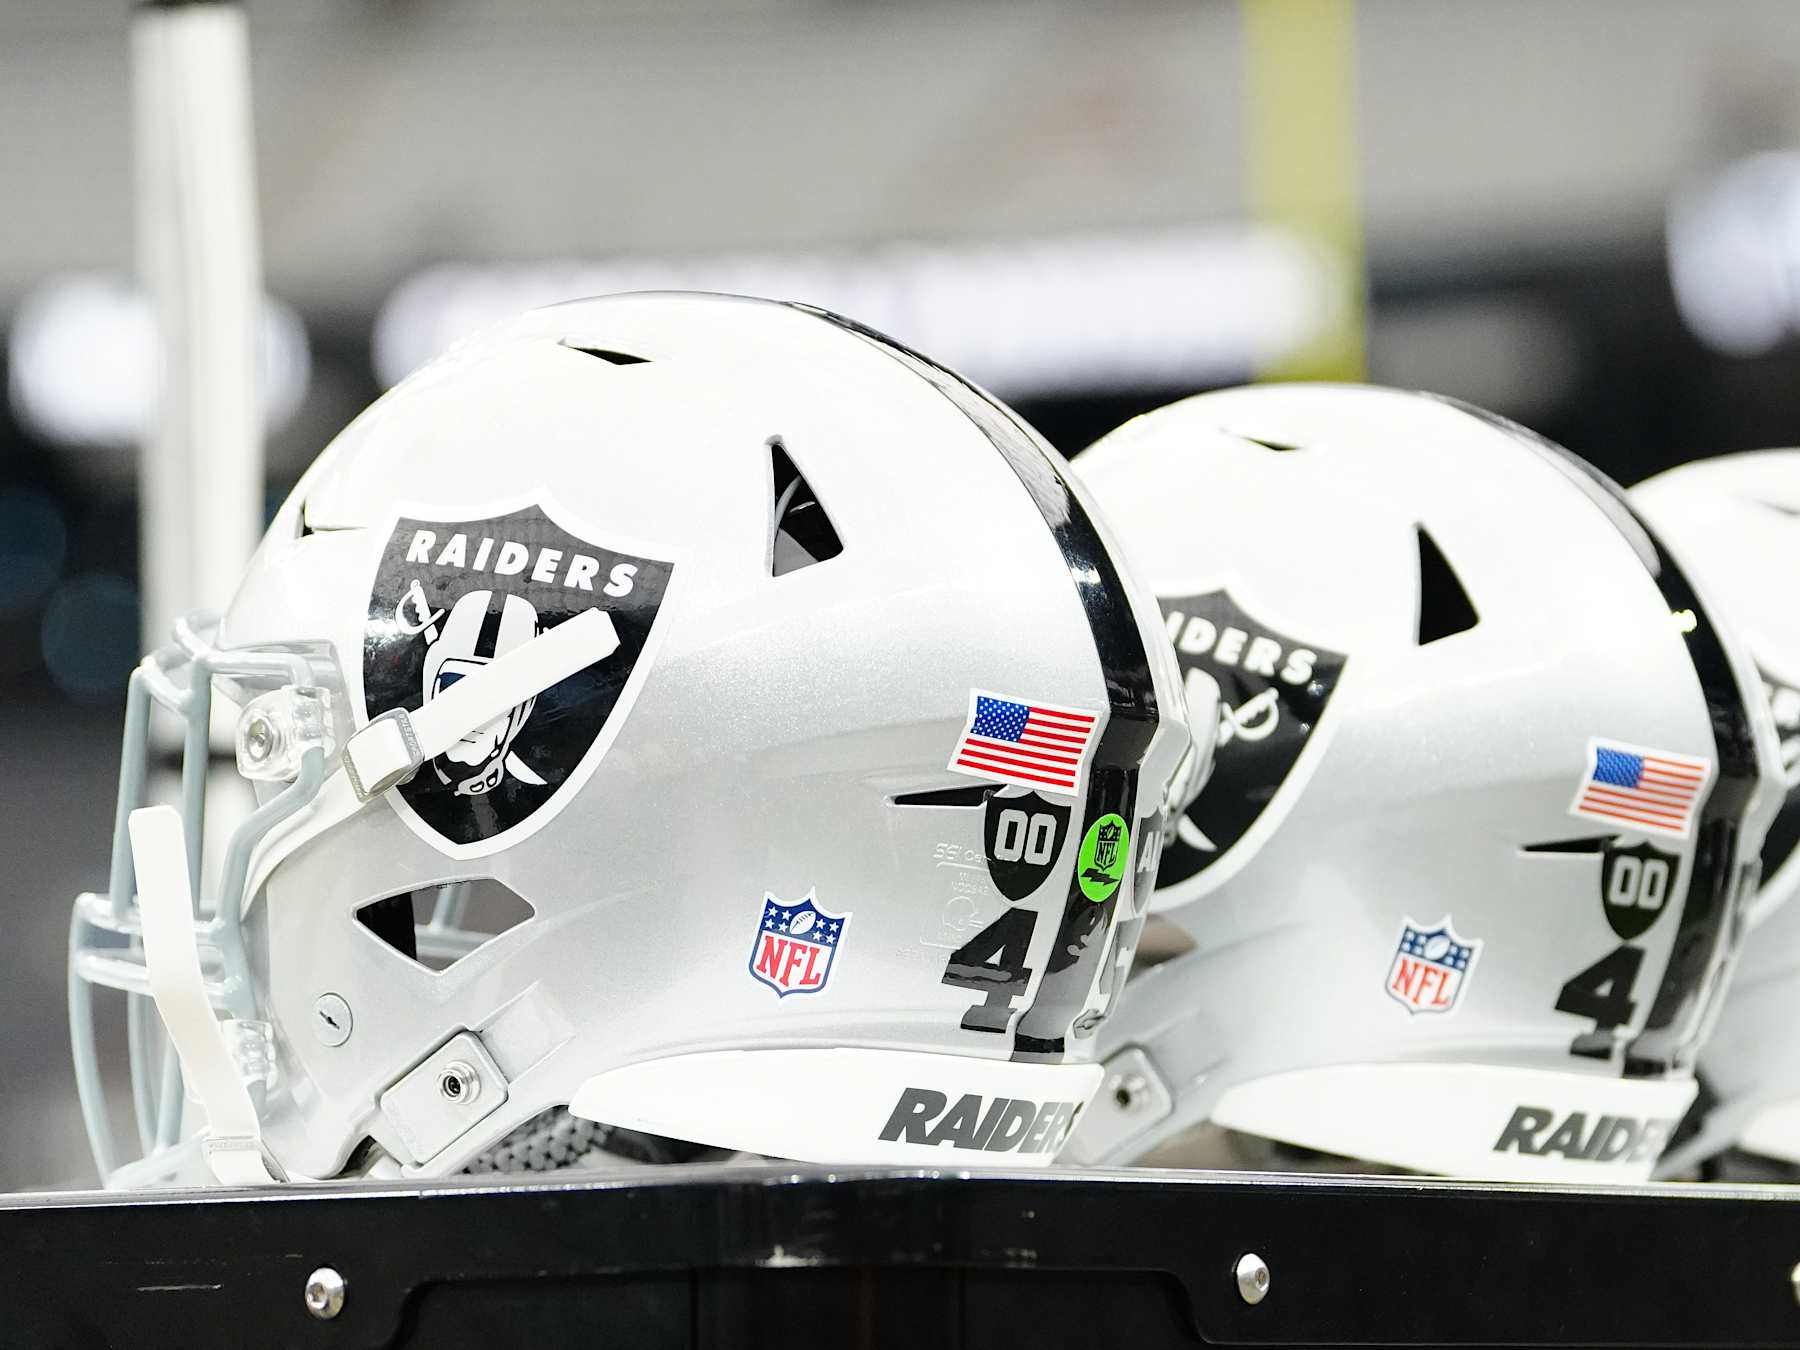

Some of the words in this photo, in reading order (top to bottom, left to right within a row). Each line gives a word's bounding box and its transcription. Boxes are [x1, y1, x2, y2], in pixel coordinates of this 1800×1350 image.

[406, 530, 639, 598] RAIDERS
[993, 808, 1057, 866] 00
[1096, 839, 1117, 867] NFL
[1608, 854, 1669, 910] 00
[756, 935, 821, 987] NFL
[941, 907, 1039, 1034] 4
[1391, 958, 1452, 1006] NFL
[1554, 945, 1646, 1060] 4
